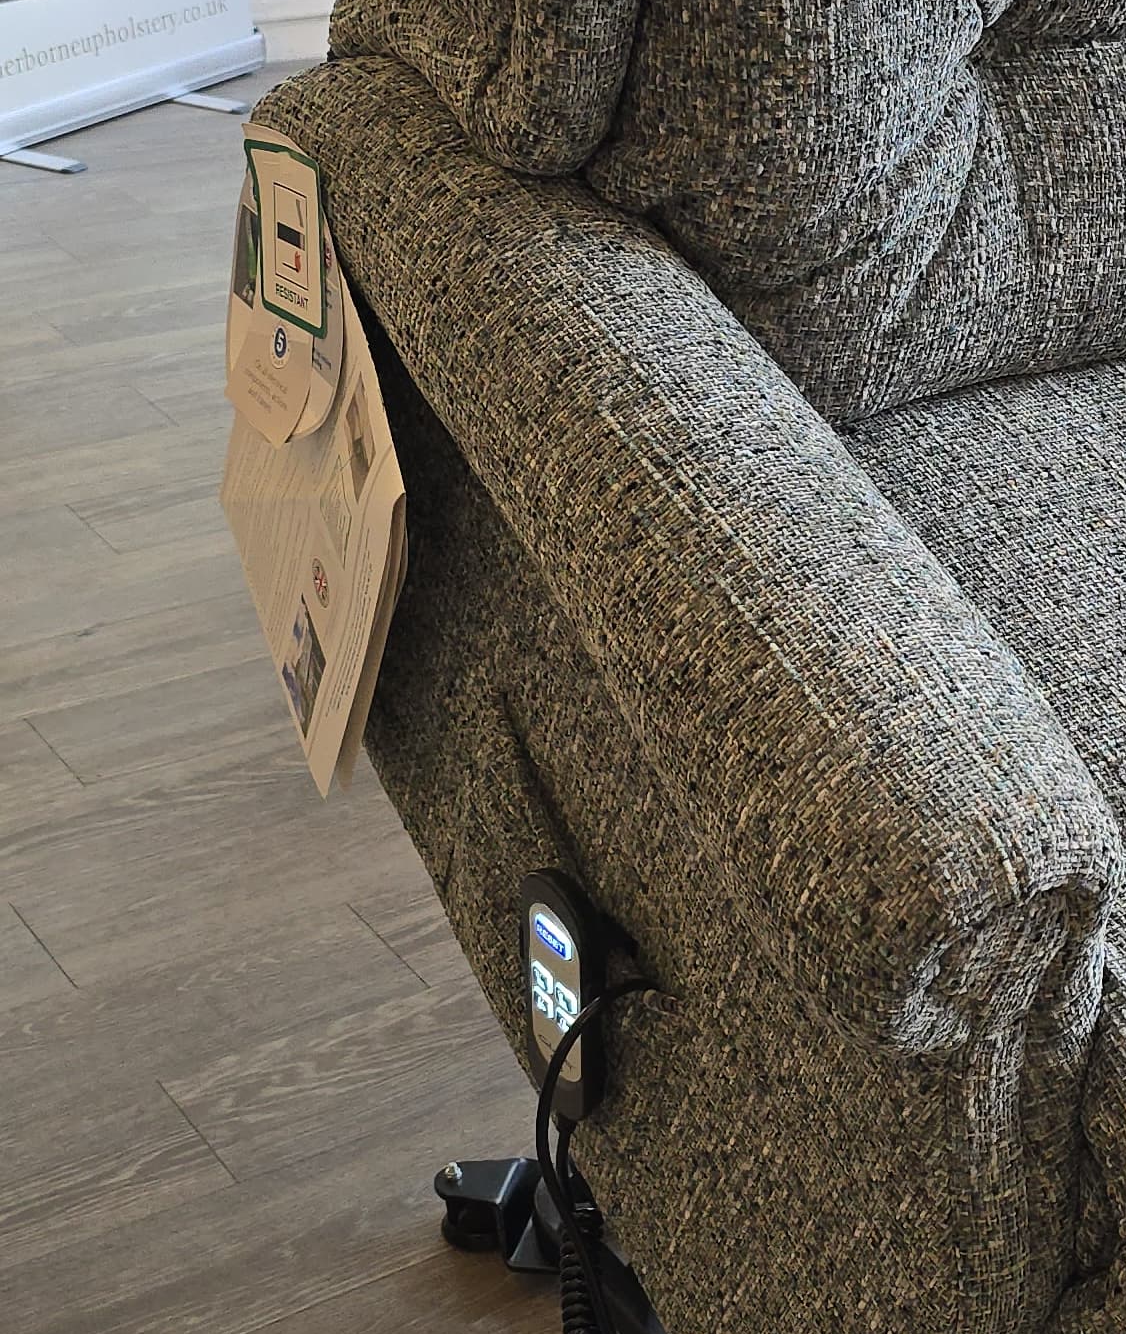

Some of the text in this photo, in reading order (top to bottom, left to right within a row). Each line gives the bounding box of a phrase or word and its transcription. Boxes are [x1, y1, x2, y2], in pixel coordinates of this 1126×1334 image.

[276, 283, 309, 309] RESISTANT
[276, 334, 285, 351] 5
[536, 923, 565, 953] RESET
